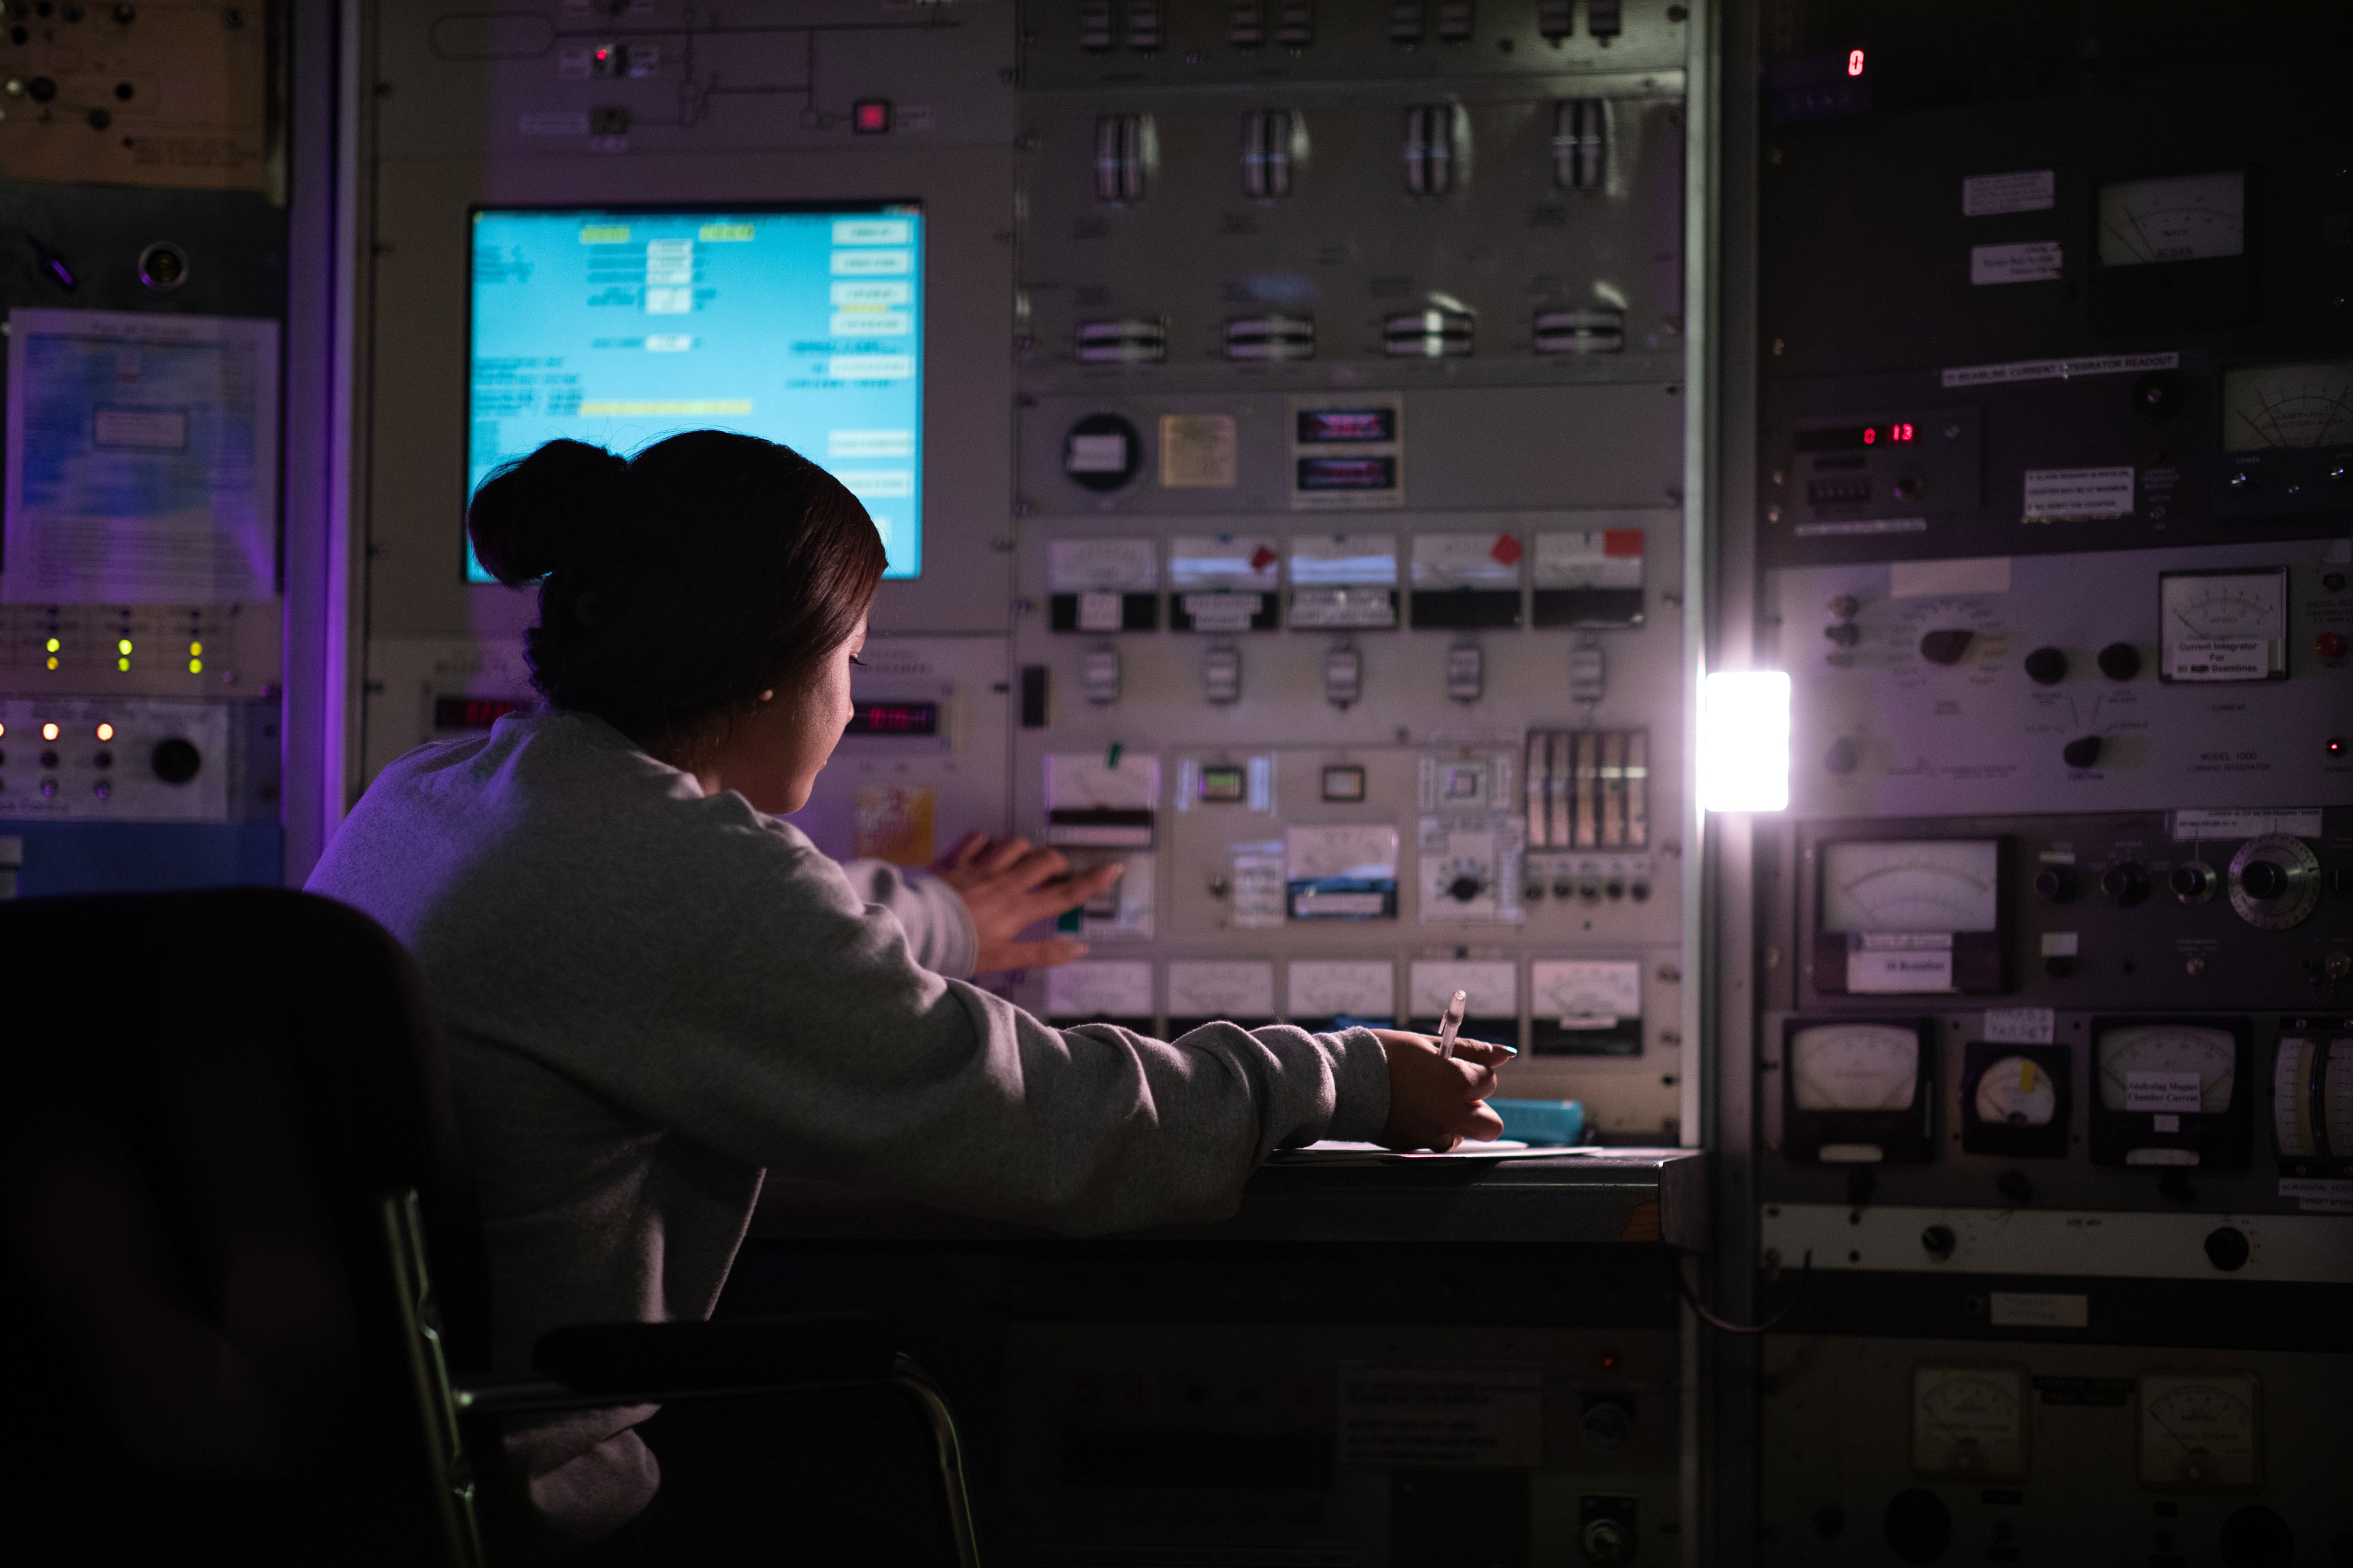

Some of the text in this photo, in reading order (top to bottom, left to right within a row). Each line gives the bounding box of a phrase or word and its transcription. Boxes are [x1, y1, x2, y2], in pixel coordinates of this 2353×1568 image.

[1848, 49, 1864, 76] 0
[2059, 360, 2121, 375] ITEGRATOR
[2125, 355, 2174, 369] READOUT
[1863, 427, 1876, 444] 0
[2180, 641, 2258, 652] Current Integrator
[2210, 653, 2225, 661] For
[2212, 664, 2258, 672] Beamlines
[2201, 752, 2229, 761] MODEL
[2223, 762, 2271, 772] INTEGRATOR
[2325, 765, 2352, 774] POWER
